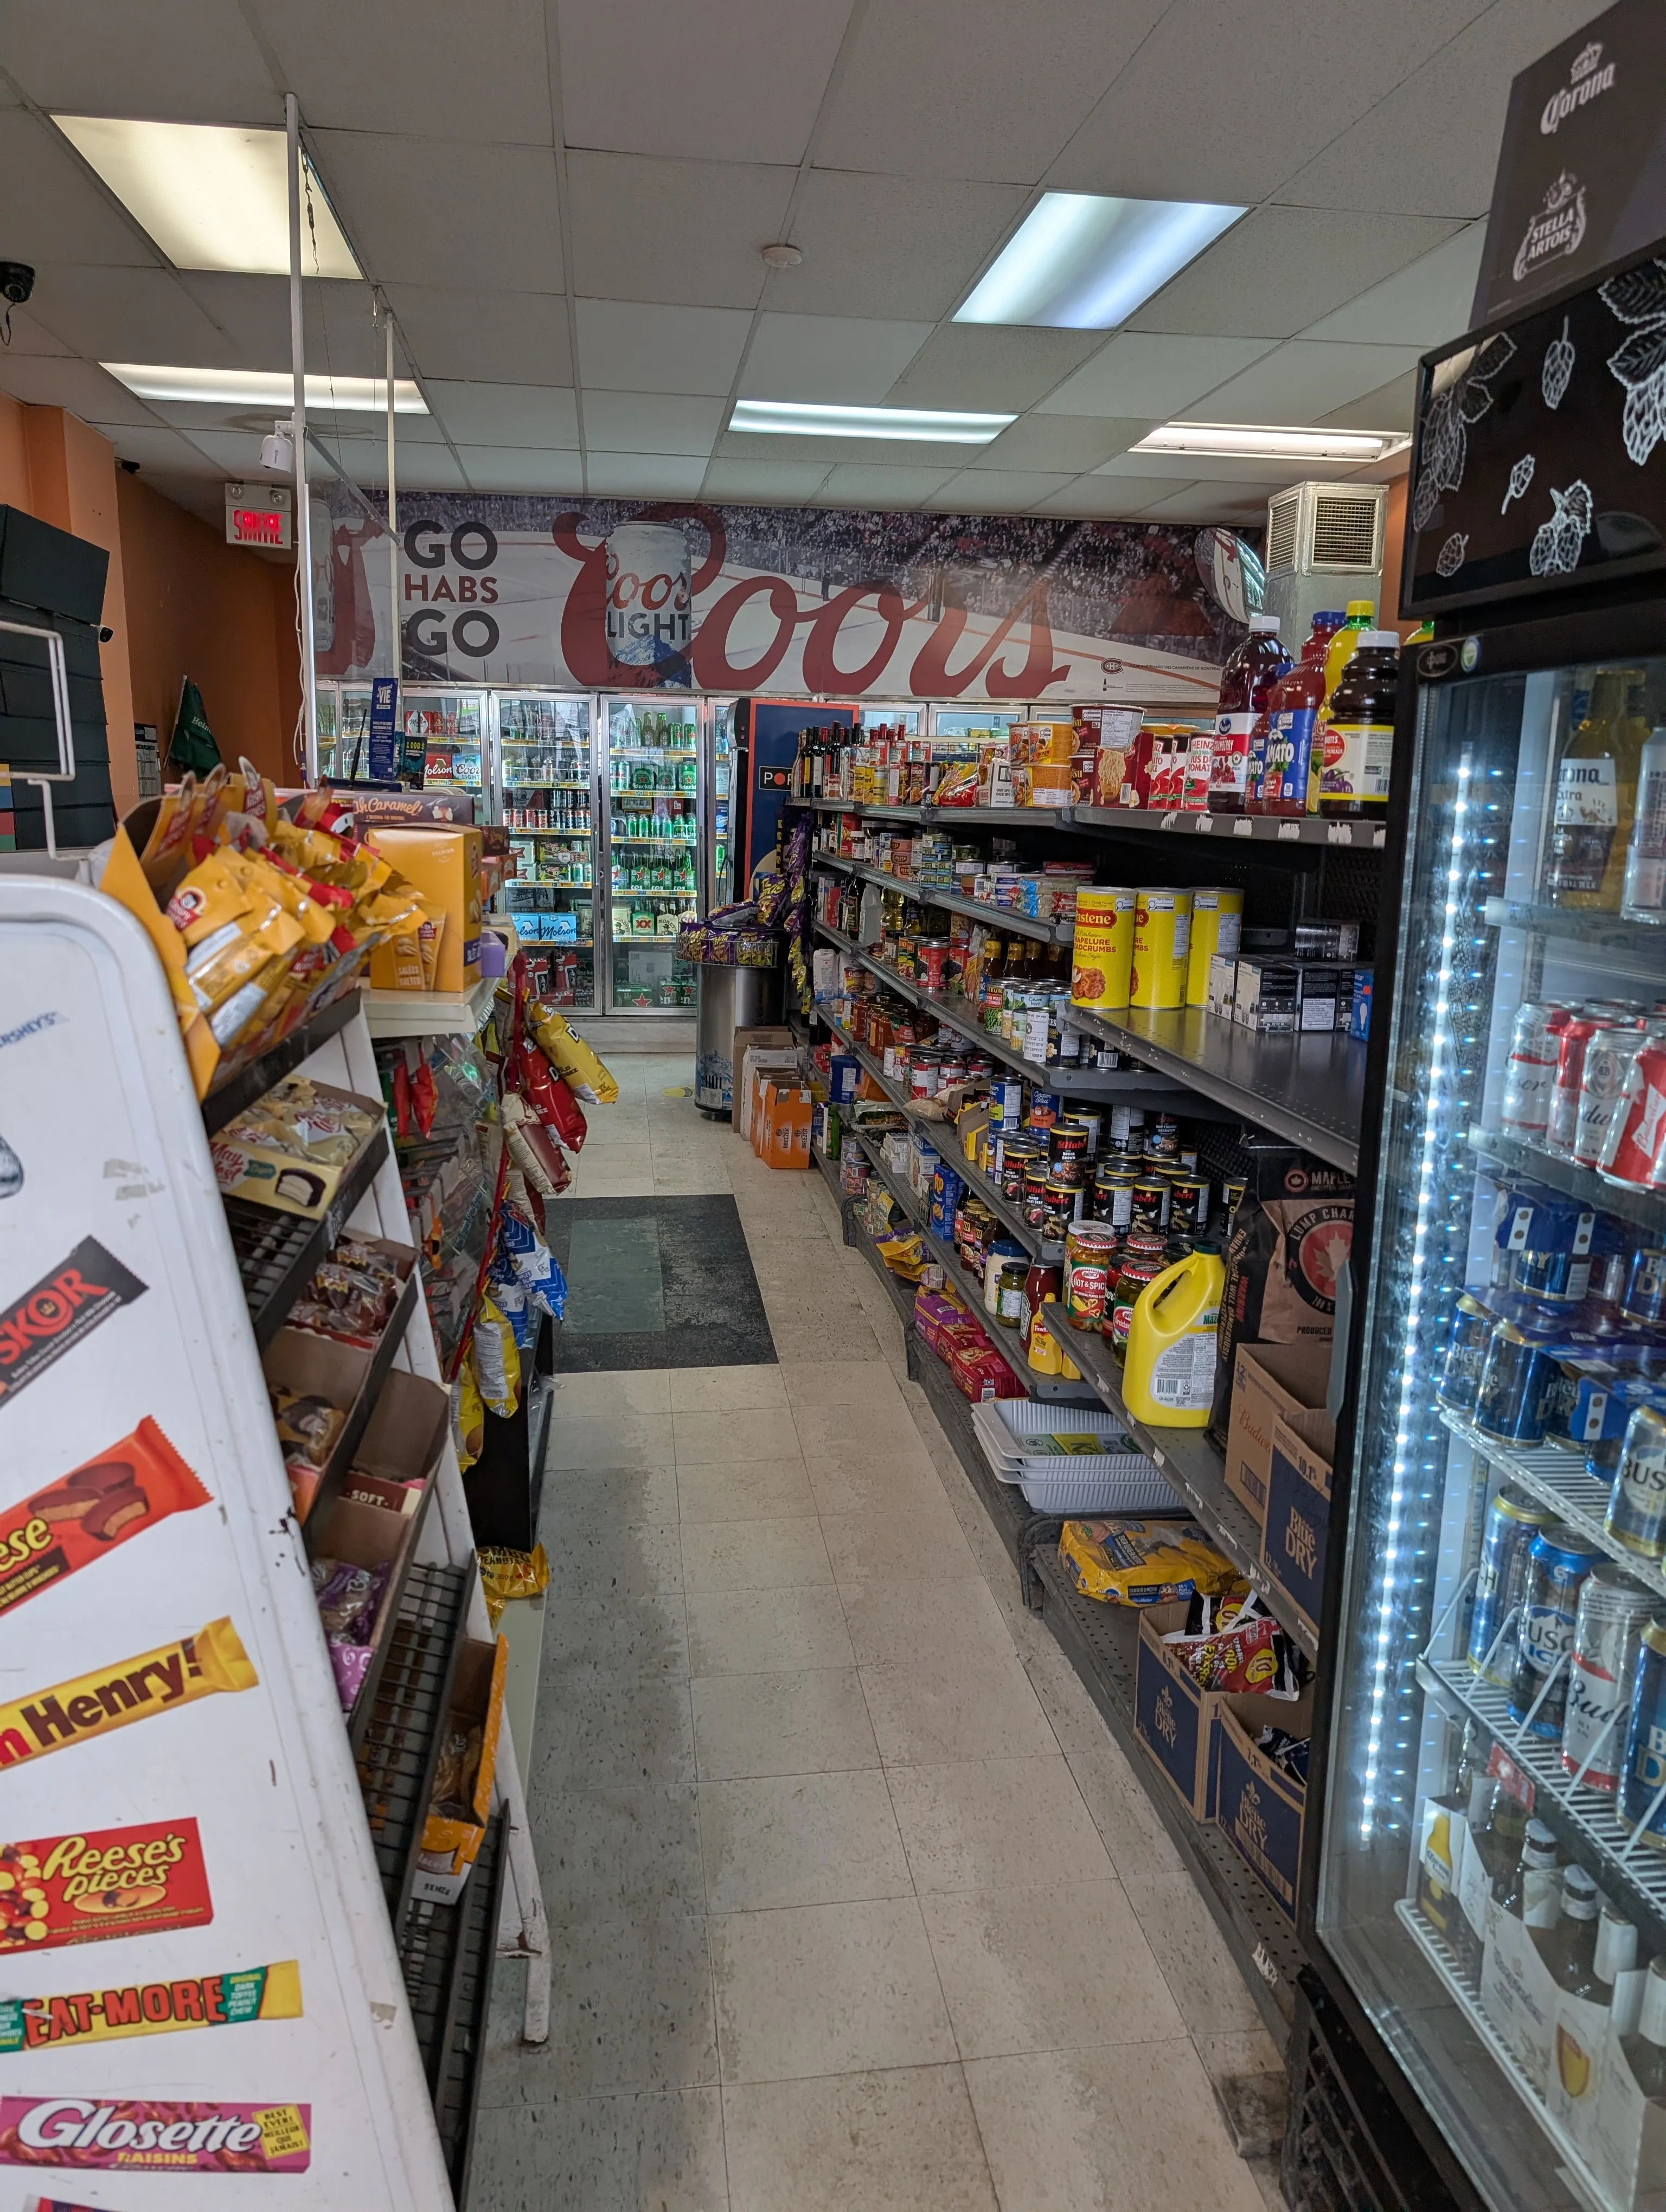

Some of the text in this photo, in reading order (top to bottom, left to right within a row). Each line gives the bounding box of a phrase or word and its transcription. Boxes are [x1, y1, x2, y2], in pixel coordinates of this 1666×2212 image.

[1540, 62, 1616, 134] Corona
[1532, 208, 1574, 241] STELLA
[1527, 226, 1572, 260] ARTOIS
[404, 519, 498, 570] GO
[405, 574, 498, 604] HABS
[552, 503, 1071, 699] Coors
[406, 608, 500, 658] GO
[607, 611, 690, 640] LIGHT
[379, 690, 391, 703] VIE
[456, 763, 481, 775] Coor
[368, 797, 423, 816] Caramel!
[542, 927, 577, 940] Molson
[1074, 943, 1116, 953] EADCRUMBS
[214, 1162, 242, 1182] est
[1290, 1213, 1317, 1241] LUMP
[1073, 1278, 1085, 1288] HOT
[1297, 1326, 1332, 1335] PRODUCED
[351, 1490, 384, 1507] SOFT
[1285, 1526, 1318, 1580] DRY
[20, 1637, 202, 1747] Henry!
[1155, 1708, 1177, 1750] DRY
[42, 1834, 186, 1881] Reese's
[62, 1864, 170, 1901] pieces
[22, 1976, 227, 2047] EAT-MORE
[18, 2099, 261, 2153] Glosette
[264, 2109, 287, 2120] BEST
[117, 2152, 198, 2165] RAISINS
